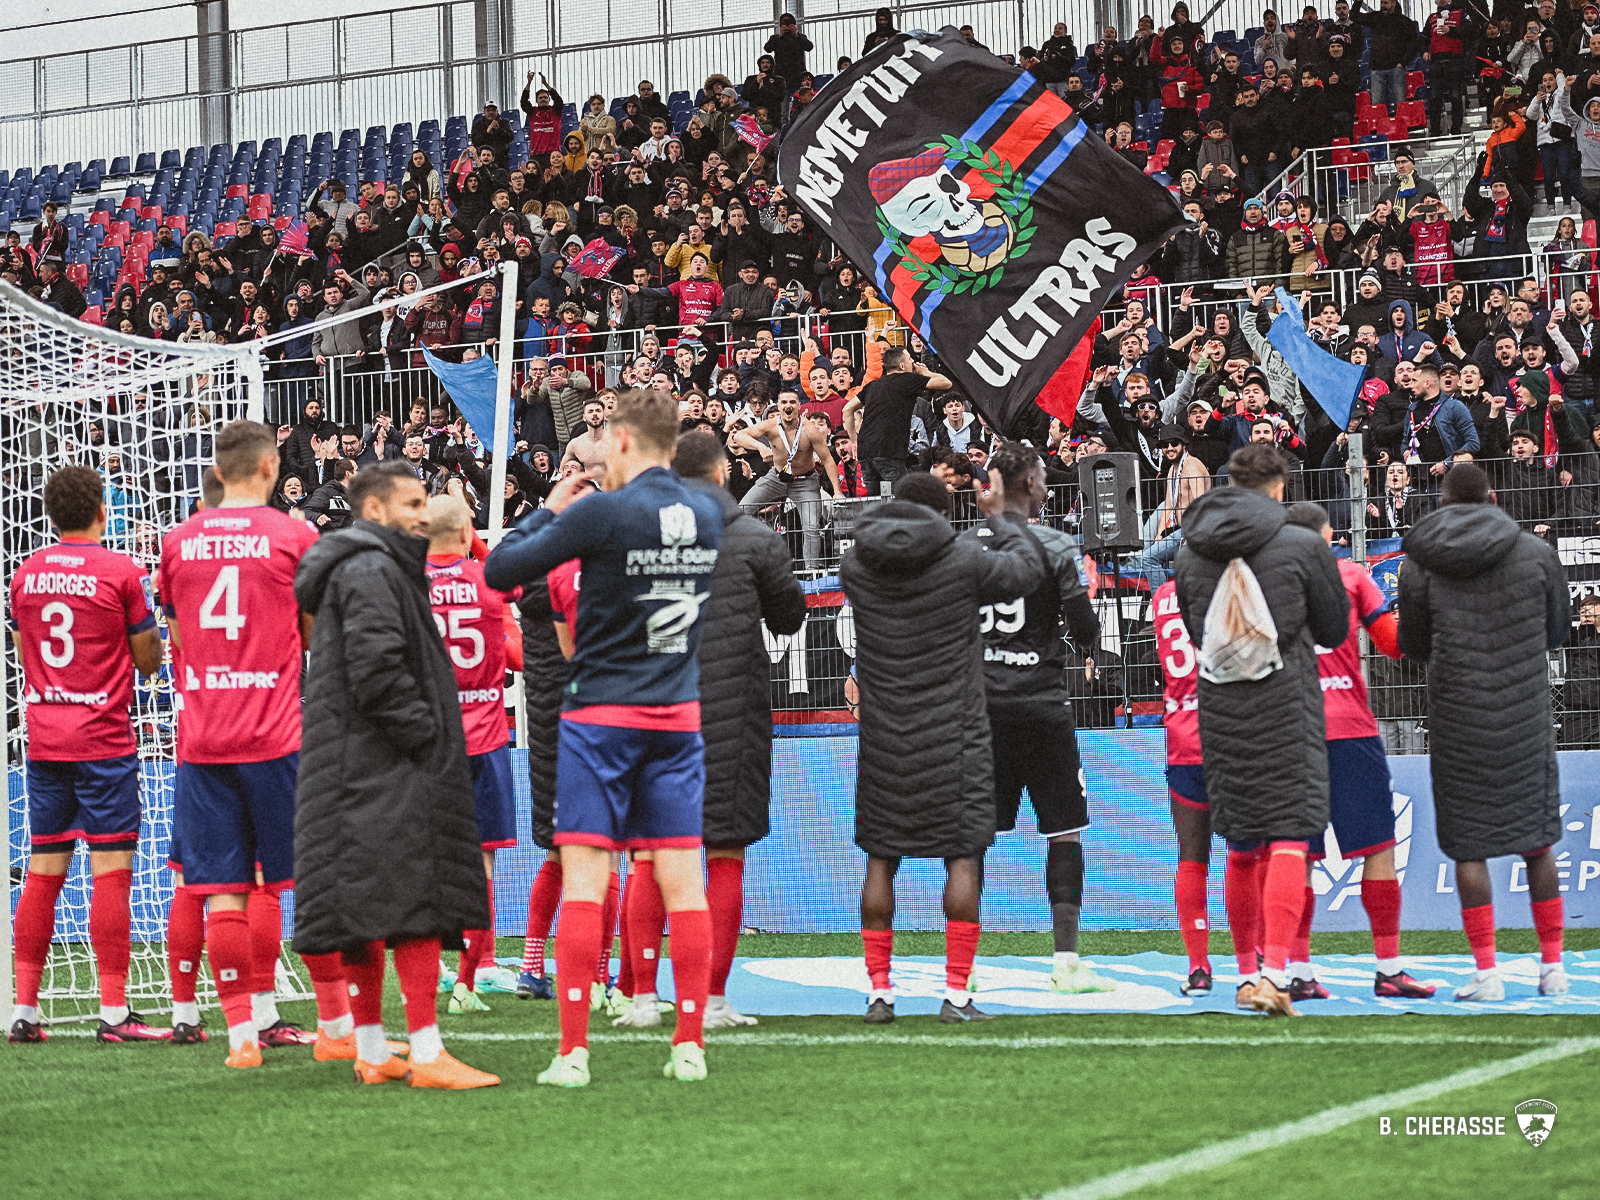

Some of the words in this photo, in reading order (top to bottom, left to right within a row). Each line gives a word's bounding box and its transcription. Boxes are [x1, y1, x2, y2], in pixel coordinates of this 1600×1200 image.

[796, 39, 944, 226] NEMETUM
[966, 217, 1138, 387] ULTRAS
[23, 572, 97, 597] N.BORGES
[199, 565, 246, 640] 4
[41, 601, 74, 668] 3
[1436, 863, 1454, 893] L
